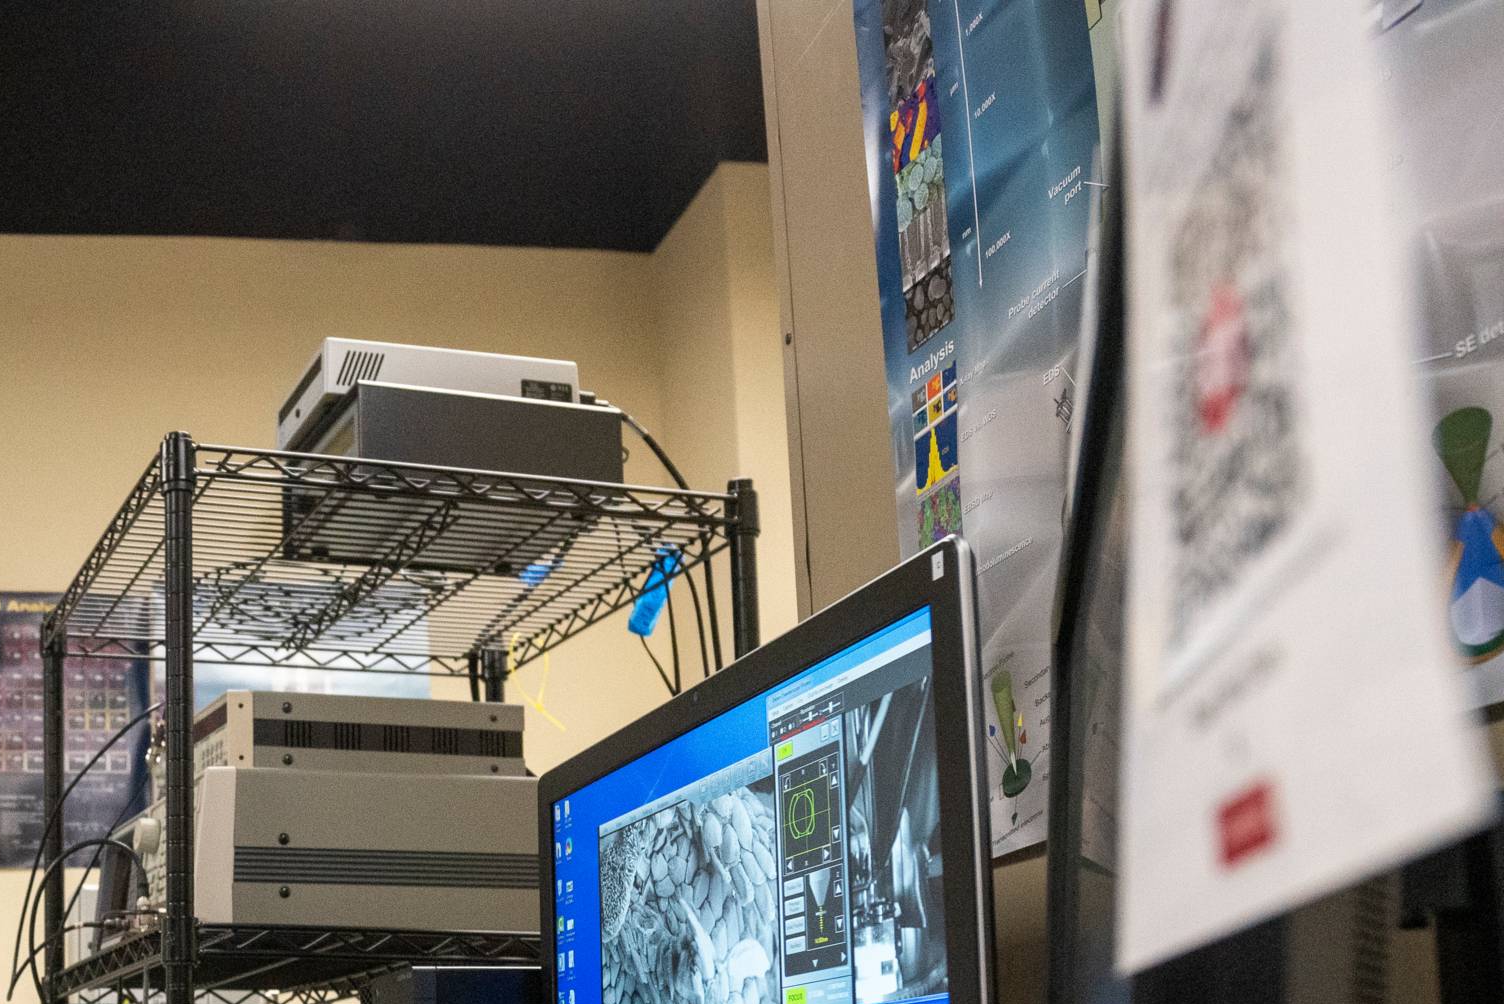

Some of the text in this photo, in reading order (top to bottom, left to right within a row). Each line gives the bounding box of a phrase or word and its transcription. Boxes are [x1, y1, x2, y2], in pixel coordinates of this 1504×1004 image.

[974, 93, 996, 119] 10.000X
[1048, 165, 1081, 200] Vacuum
[1064, 180, 1082, 206] port
[1008, 268, 1061, 320] Probe current
[1028, 287, 1060, 319] detector
[1456, 333, 1477, 358] SE
[909, 339, 955, 384] Analysis
[1042, 364, 1061, 386] EDS
